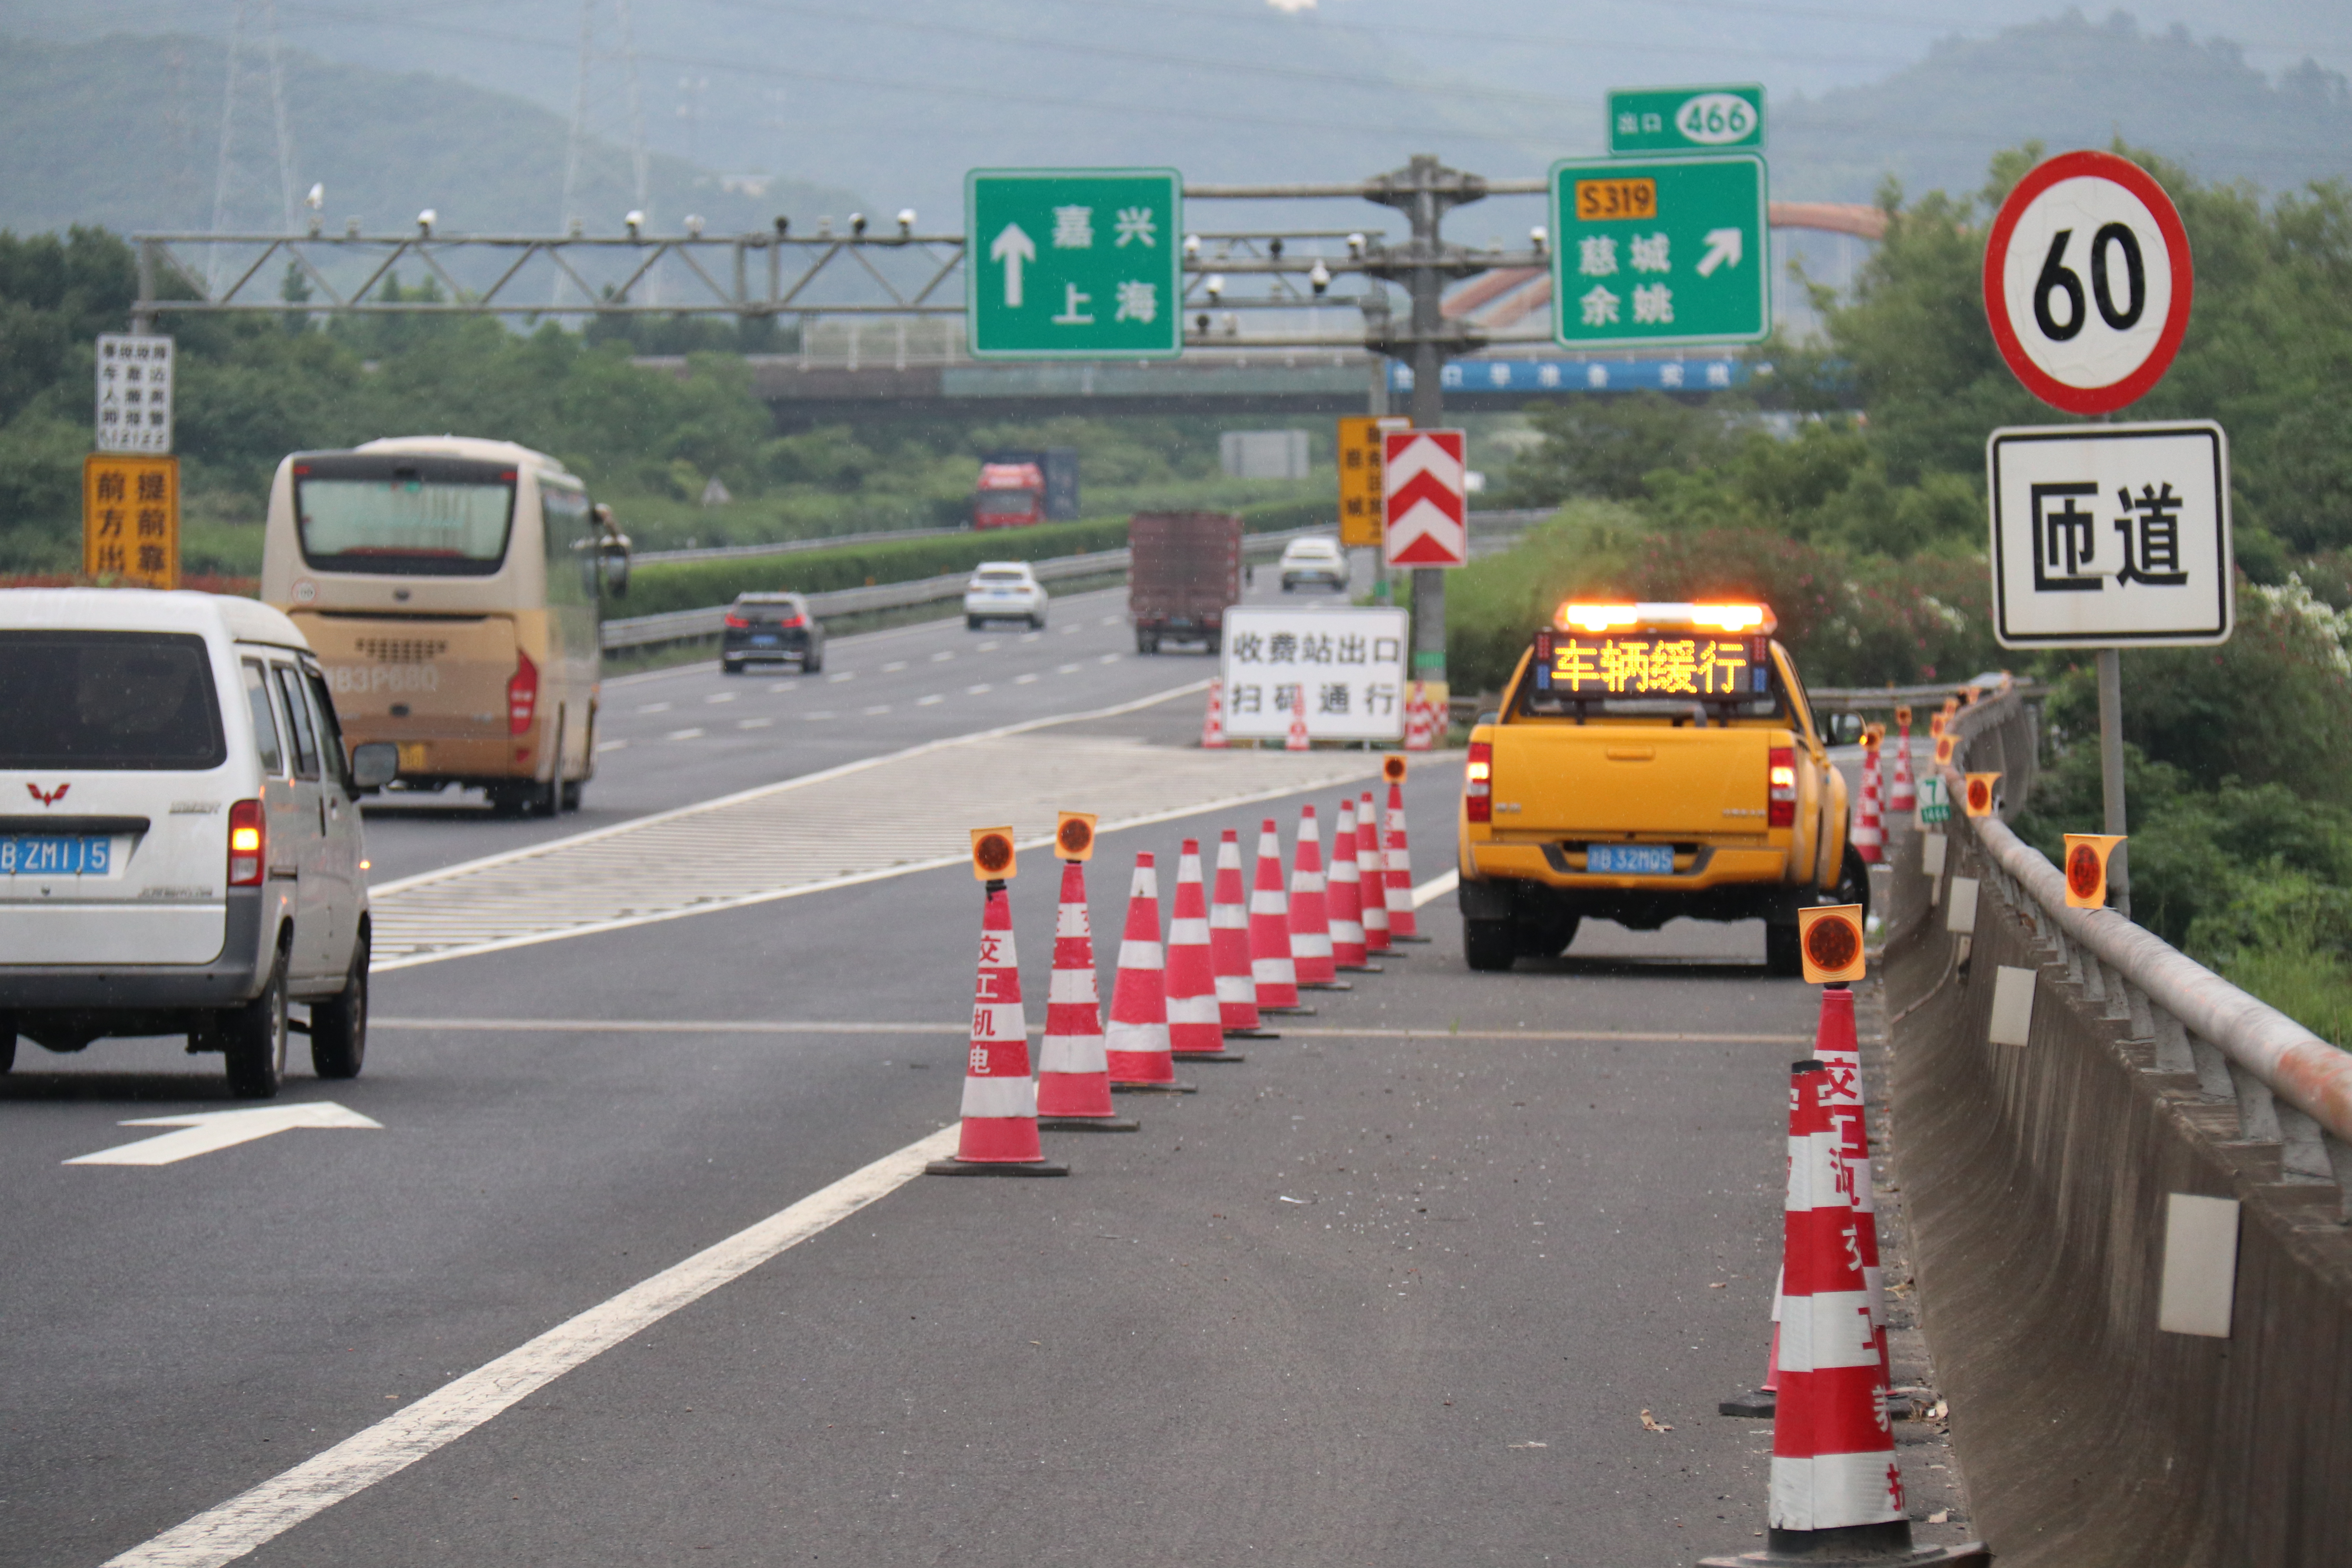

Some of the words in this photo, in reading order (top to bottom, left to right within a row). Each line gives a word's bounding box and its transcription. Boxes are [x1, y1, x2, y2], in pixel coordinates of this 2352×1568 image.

[1617, 111, 1662, 136] 出口
[1685, 101, 1747, 134] 466
[1582, 183, 1651, 214] S319
[1051, 203, 1158, 249] 嘉兴
[1577, 232, 1672, 277] 慈城
[1051, 279, 1158, 325] 上海
[1579, 281, 1675, 328] 余姚
[2034, 221, 2146, 342] 60
[2030, 481, 2189, 592] 匝道
[1232, 632, 1401, 664] 收费站出口
[1551, 638, 1747, 693] 车辆缓行
[1231, 682, 1396, 716] 扫码通行
[1925, 779, 1937, 804] 7
[969, 935, 1002, 1074] 交工机电
